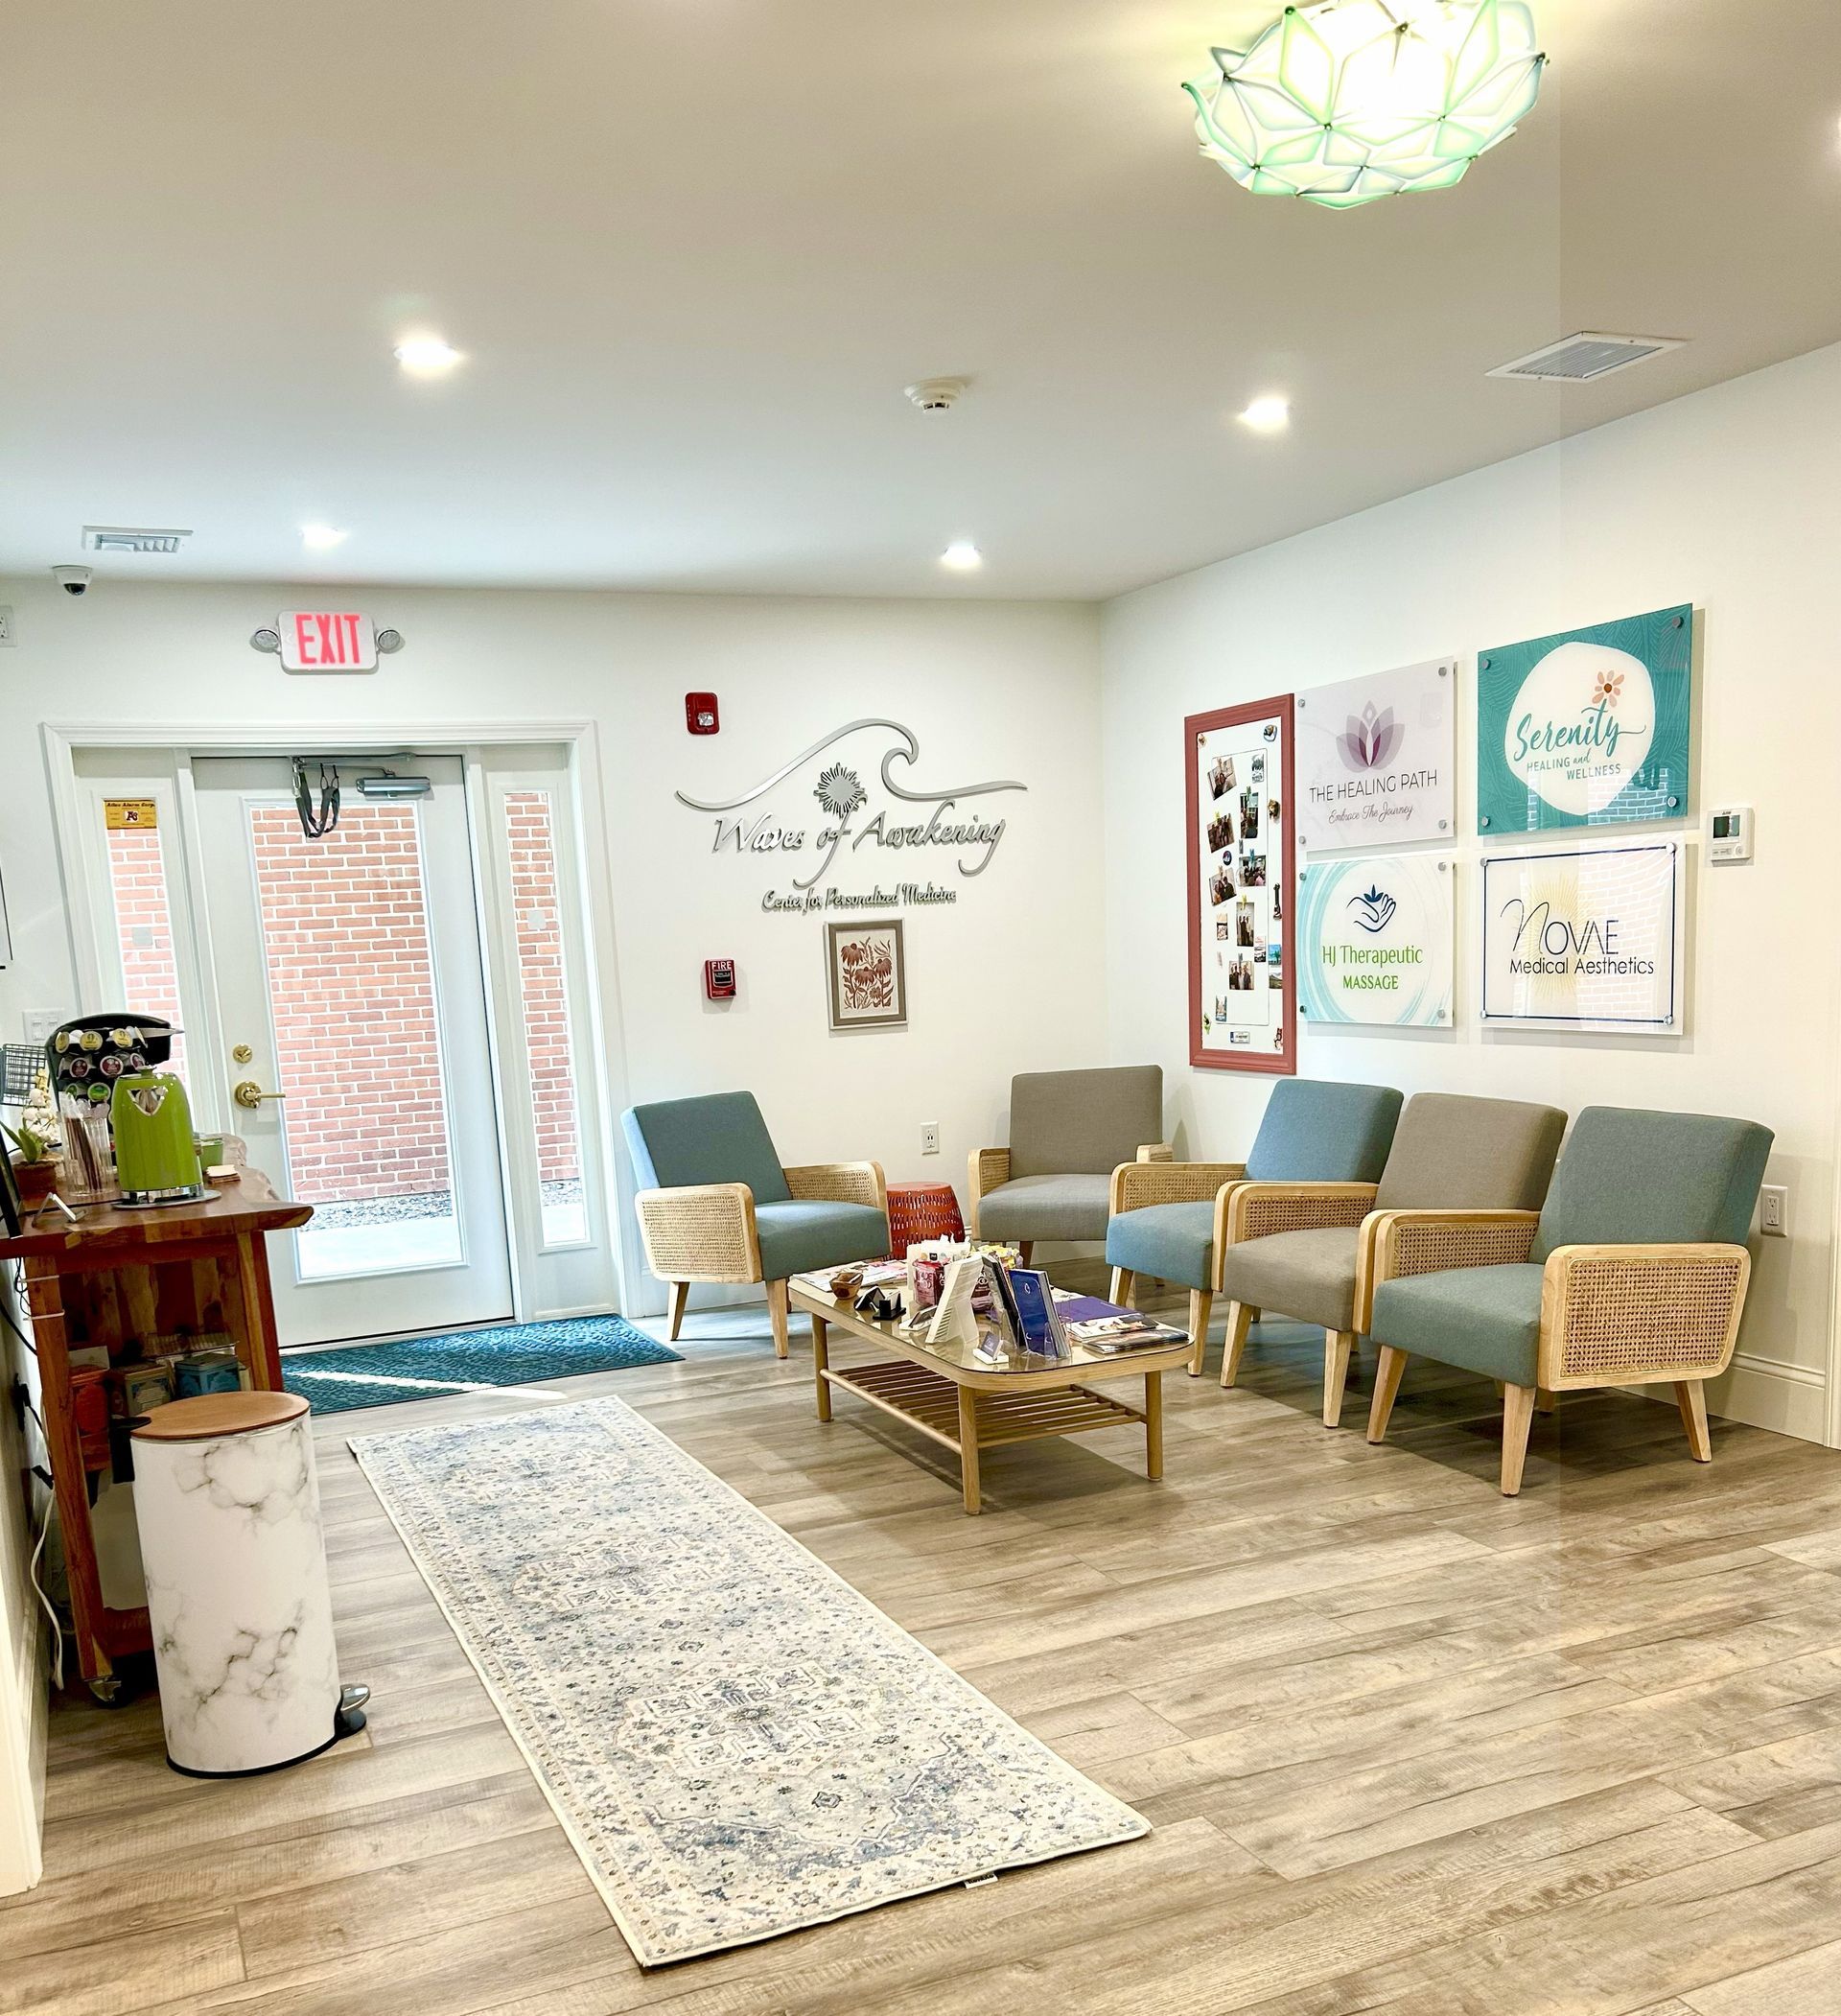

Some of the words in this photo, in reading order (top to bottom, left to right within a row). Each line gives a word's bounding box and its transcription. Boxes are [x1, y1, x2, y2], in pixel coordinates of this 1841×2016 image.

[295, 613, 361, 665] EXIT
[1513, 698, 1647, 762] Serenity
[1526, 757, 1571, 773] HEALING
[1573, 747, 1592, 764] and
[1566, 762, 1621, 781] WELLNESS
[1309, 785, 1334, 803] THE
[1338, 775, 1397, 800] HEALING
[1400, 769, 1437, 790] PATH
[1328, 806, 1361, 825] Embrace
[1363, 803, 1379, 820] The
[1378, 801, 1414, 823] Journey
[712, 811, 806, 852] Waves
[793, 795, 868, 889] of
[852, 799, 1006, 877] Awakening
[761, 889, 804, 912] Center
[802, 886, 822, 916] for
[825, 883, 901, 910] Personalized
[901, 881, 957, 905] Medicine
[1500, 899, 1620, 955] NOVAE
[711, 961, 732, 970] FIRE
[1322, 945, 1336, 968] HJ
[1340, 945, 1424, 969] Therapeutic
[1509, 957, 1569, 974] Medical
[1573, 956, 1654, 974] Aesthetics
[1342, 974, 1399, 990] MASSAGE
